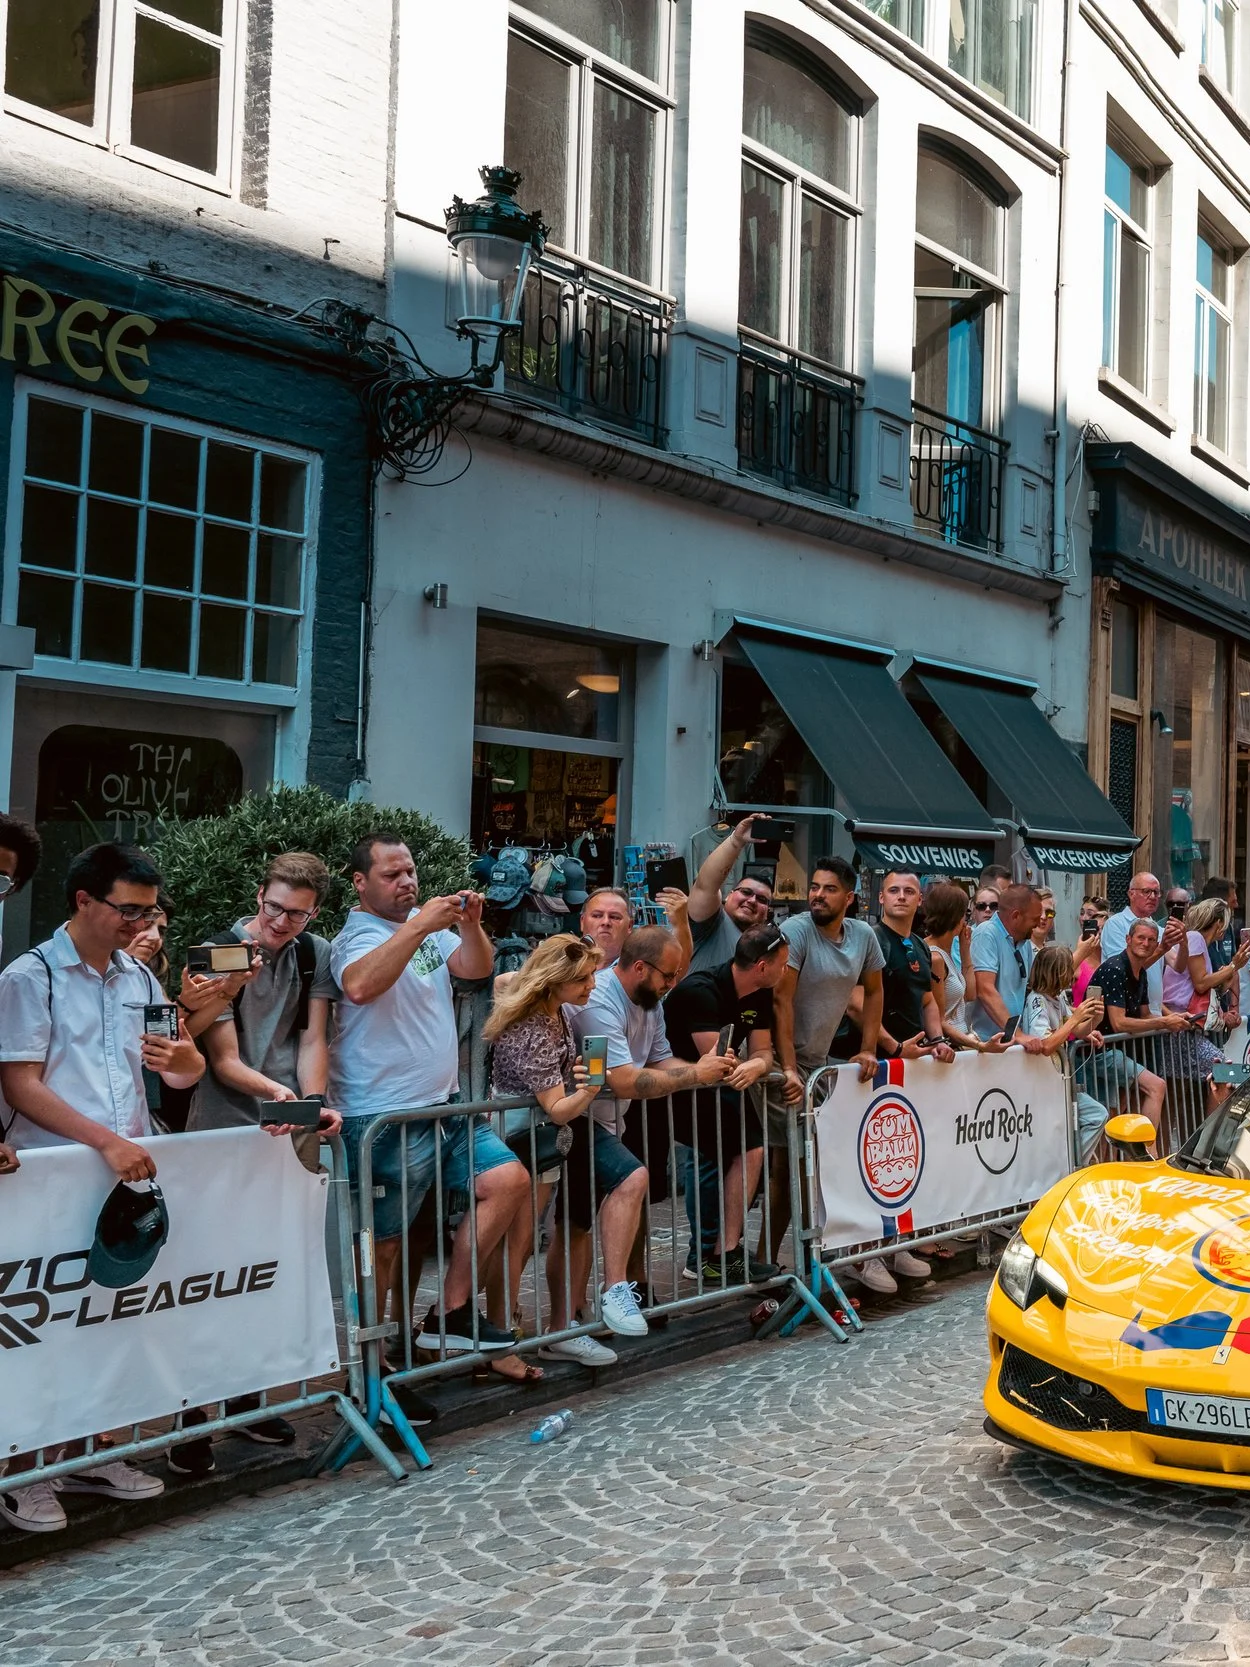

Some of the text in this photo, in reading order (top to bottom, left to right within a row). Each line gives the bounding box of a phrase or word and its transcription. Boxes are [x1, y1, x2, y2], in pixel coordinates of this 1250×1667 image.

[1137, 509, 1248, 602] APOTHEEK
[877, 843, 984, 870] SOUVENIRS
[867, 1112, 914, 1141] GUM
[955, 1104, 1033, 1145] Hard Rock
[867, 1134, 915, 1166] BALL
[870, 1158, 916, 1190] 3000
